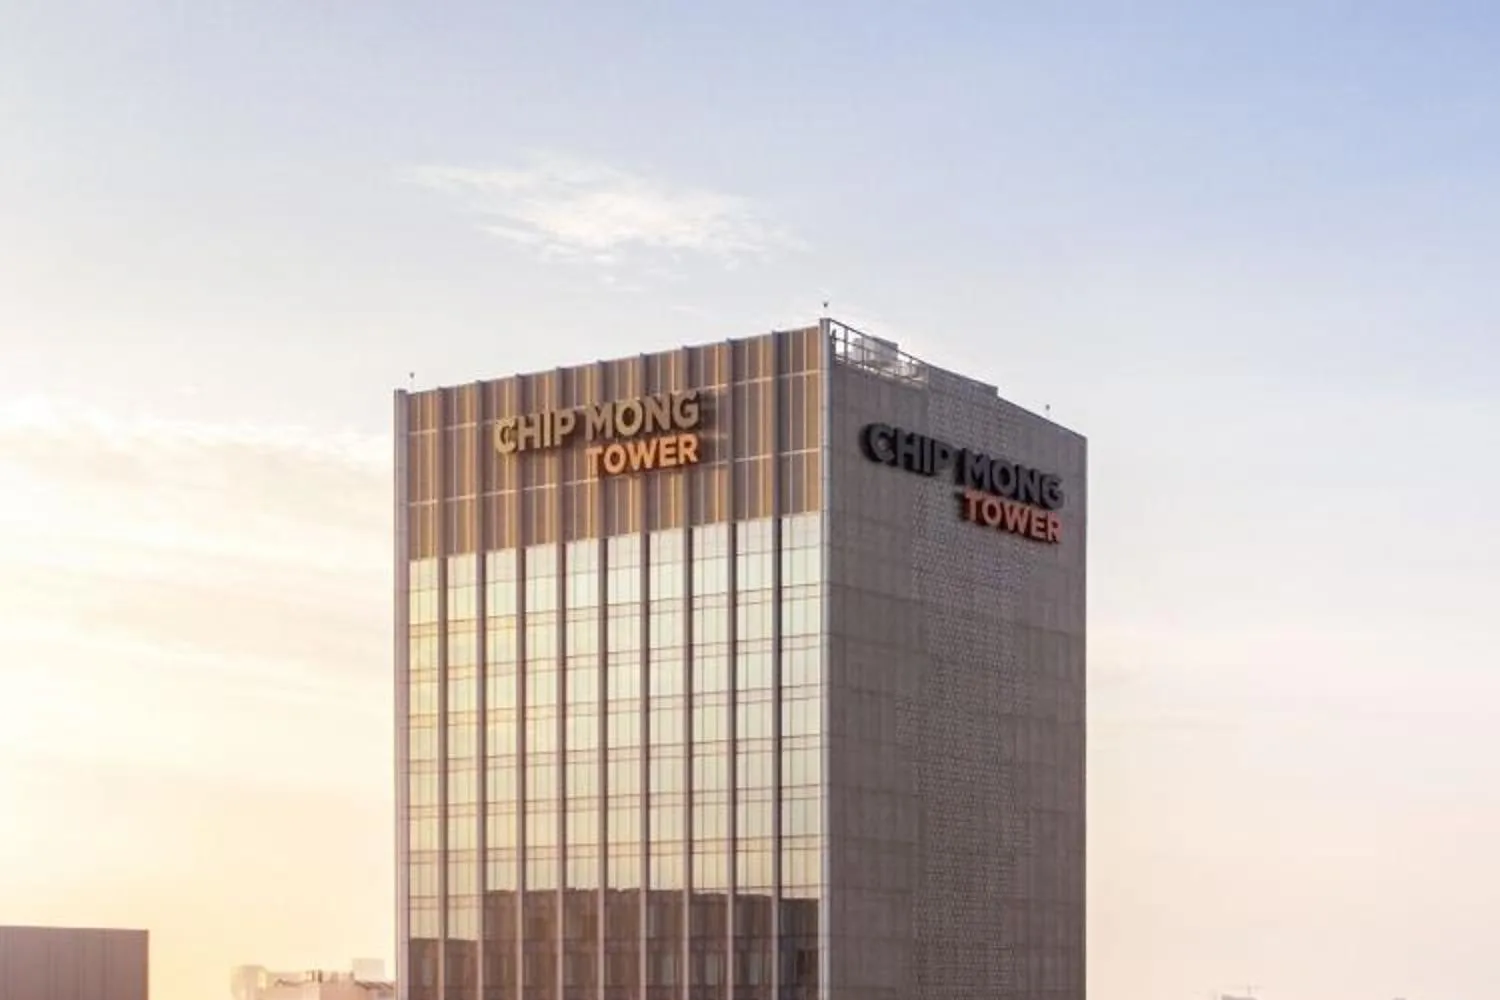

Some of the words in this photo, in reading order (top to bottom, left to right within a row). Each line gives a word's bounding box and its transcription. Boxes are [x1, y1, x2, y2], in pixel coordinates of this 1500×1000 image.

[493, 410, 576, 453] CHIP
[585, 390, 700, 442] MONG
[587, 433, 699, 475] TOWER
[861, 423, 954, 475] CHIP
[957, 449, 1065, 509] MONG
[962, 486, 1063, 542] TOWER
